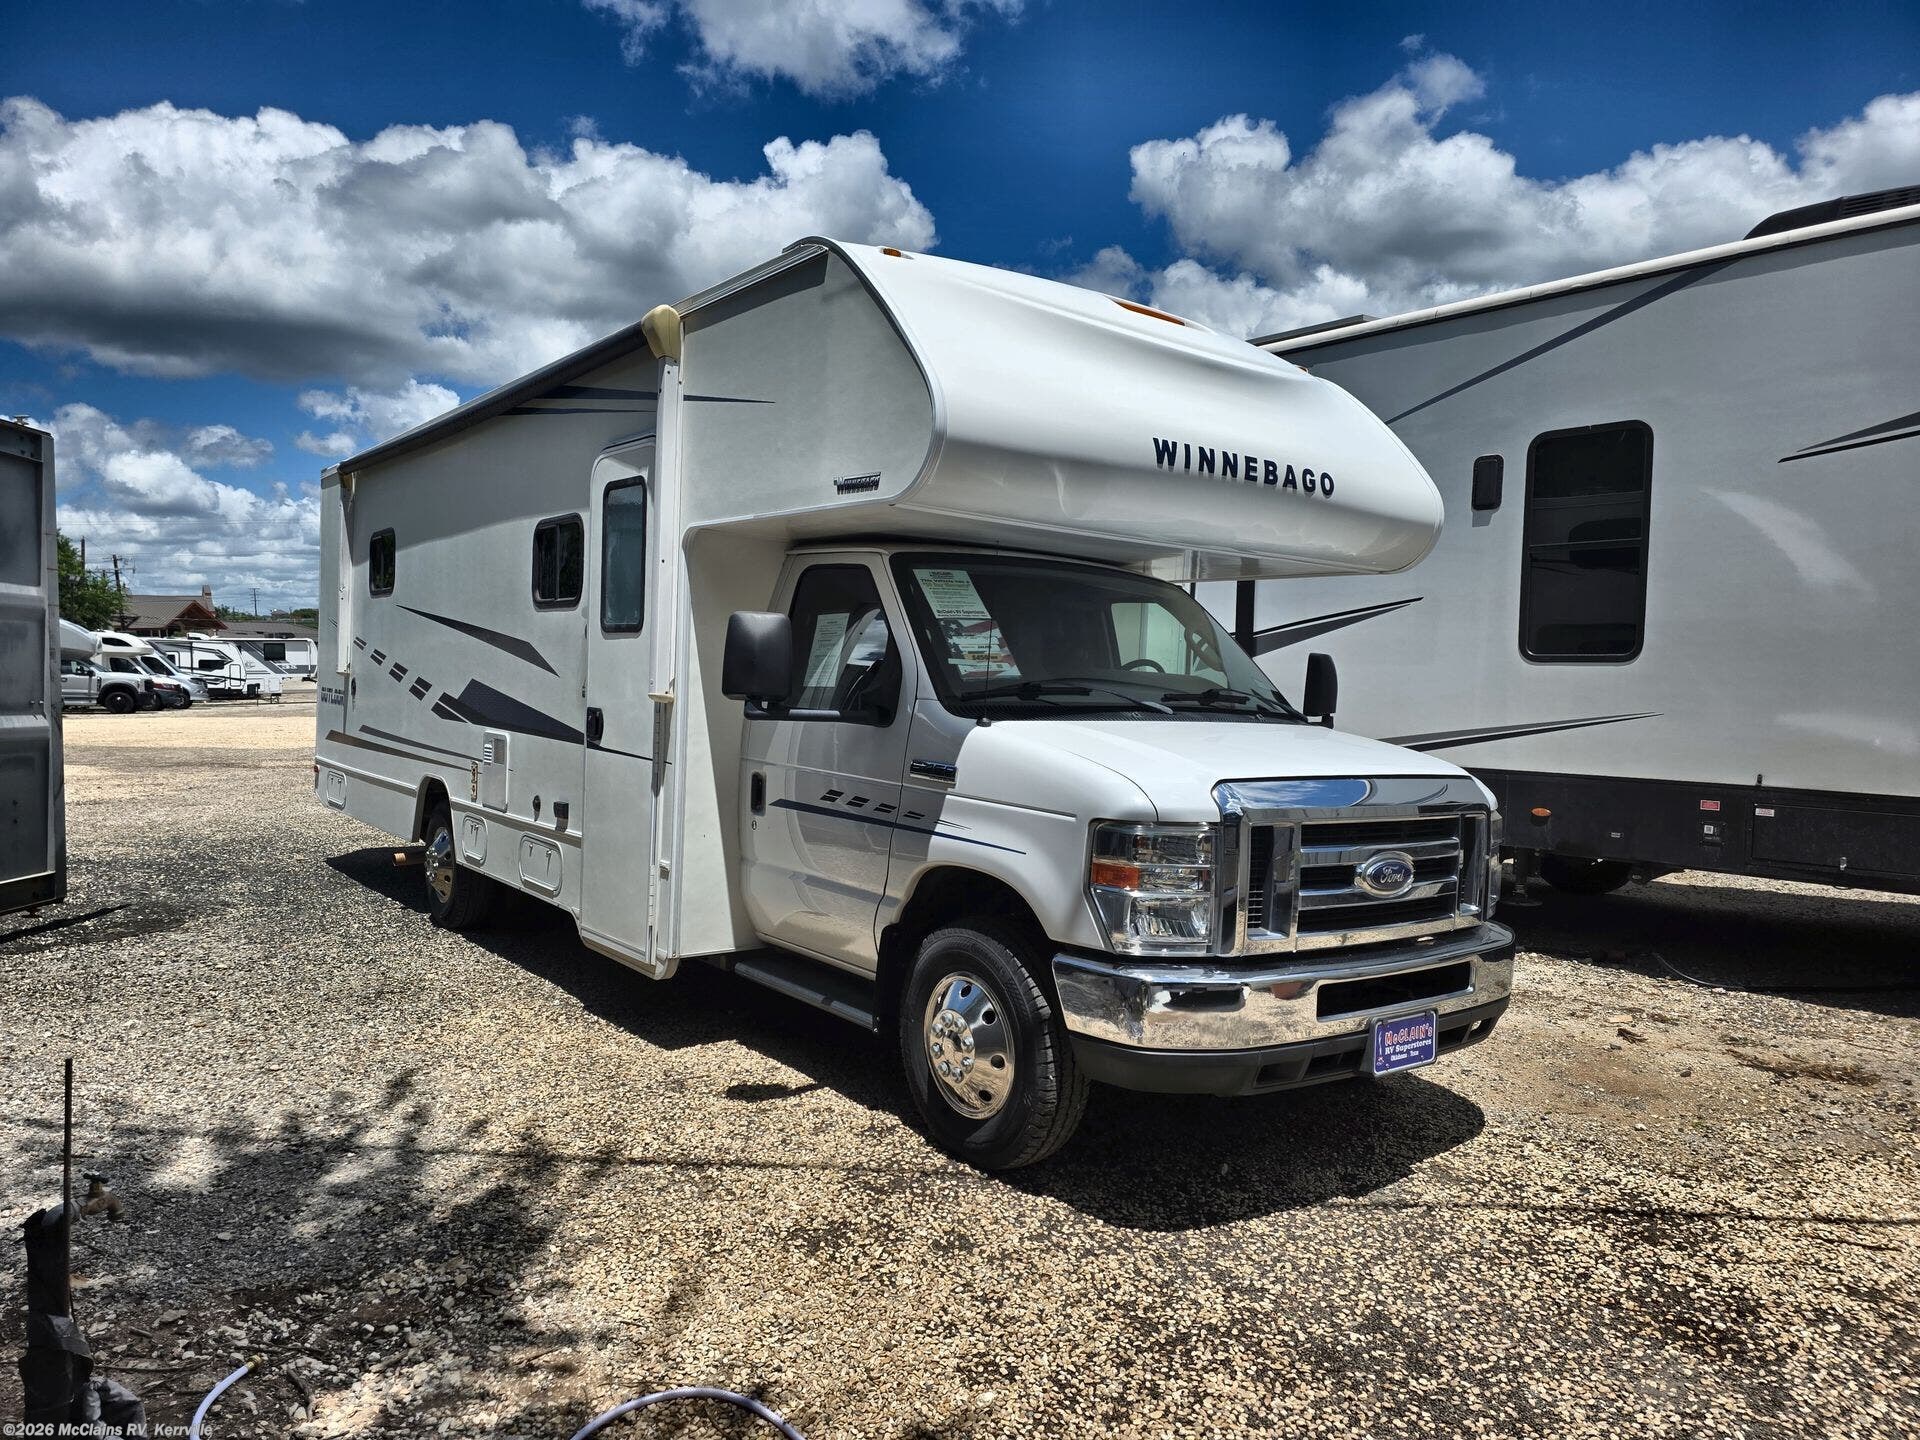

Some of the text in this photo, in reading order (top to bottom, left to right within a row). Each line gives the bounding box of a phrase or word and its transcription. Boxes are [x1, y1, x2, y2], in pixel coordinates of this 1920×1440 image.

[1153, 437, 1335, 497] WINNEBAGO
[1380, 865, 1405, 884] Ford
[1385, 1039, 1432, 1055] RV Superstores
